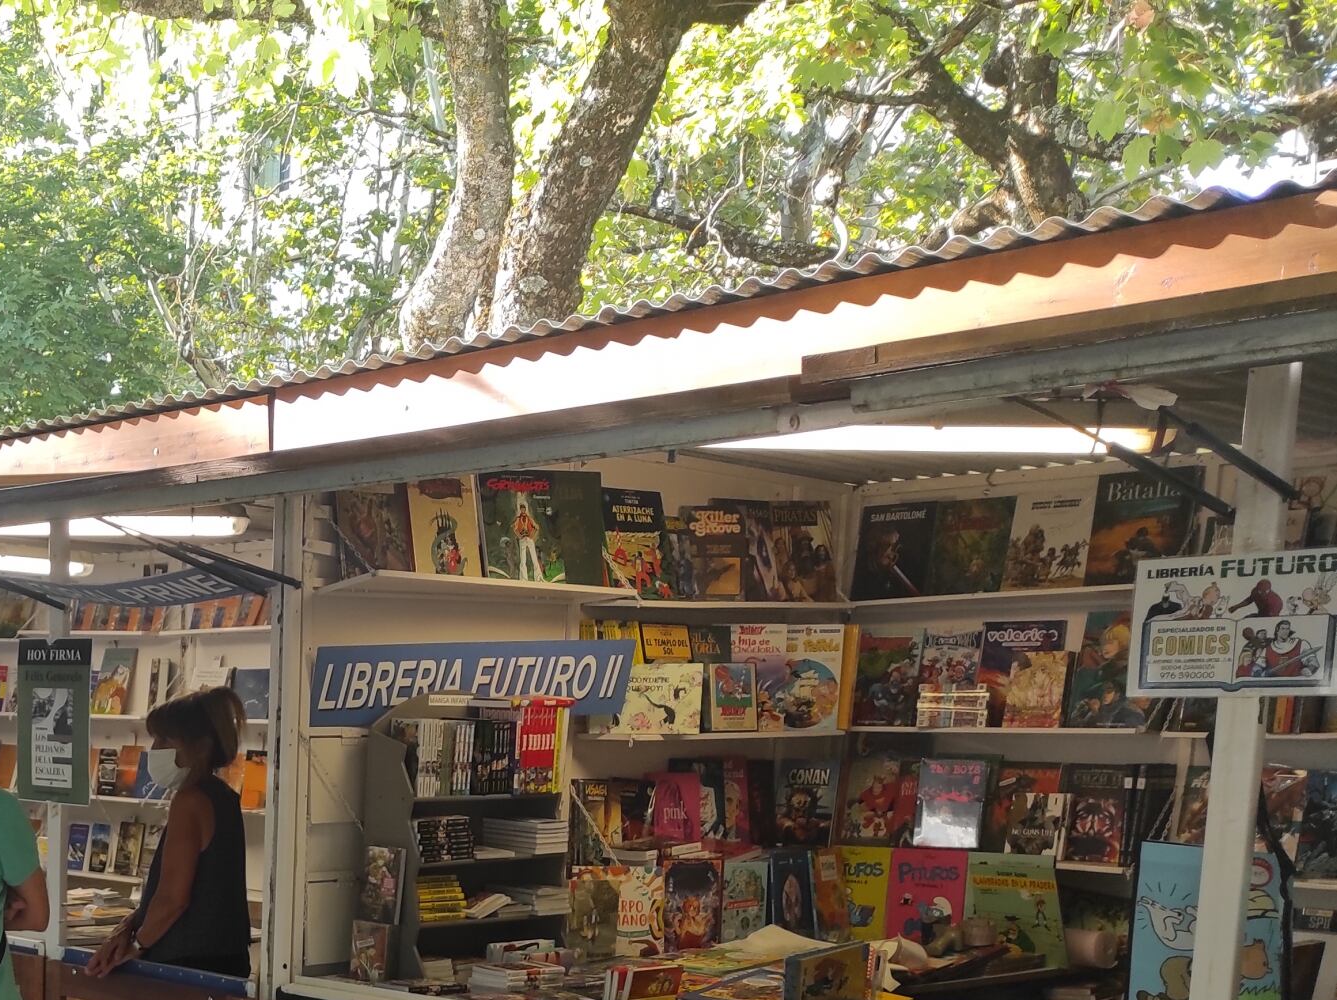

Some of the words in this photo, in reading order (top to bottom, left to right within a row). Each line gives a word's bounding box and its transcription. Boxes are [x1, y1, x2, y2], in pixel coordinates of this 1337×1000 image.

[695, 510, 740, 524] Killer
[870, 512, 884, 523] SAN
[689, 522, 741, 537] Groove
[1147, 566, 1215, 580] LIBRERÍA
[1220, 553, 1337, 579] FUTURO
[1151, 634, 1231, 657] COMICS
[27, 649, 46, 661] HOY
[49, 649, 81, 661] FIRMA
[318, 658, 463, 710] LIBRERIA
[471, 655, 598, 699] FUTURO
[599, 654, 624, 698] II
[789, 769, 830, 786] CONAN
[585, 784, 608, 797] USAGI
[663, 801, 687, 824] pink
[621, 900, 644, 913] RPO
